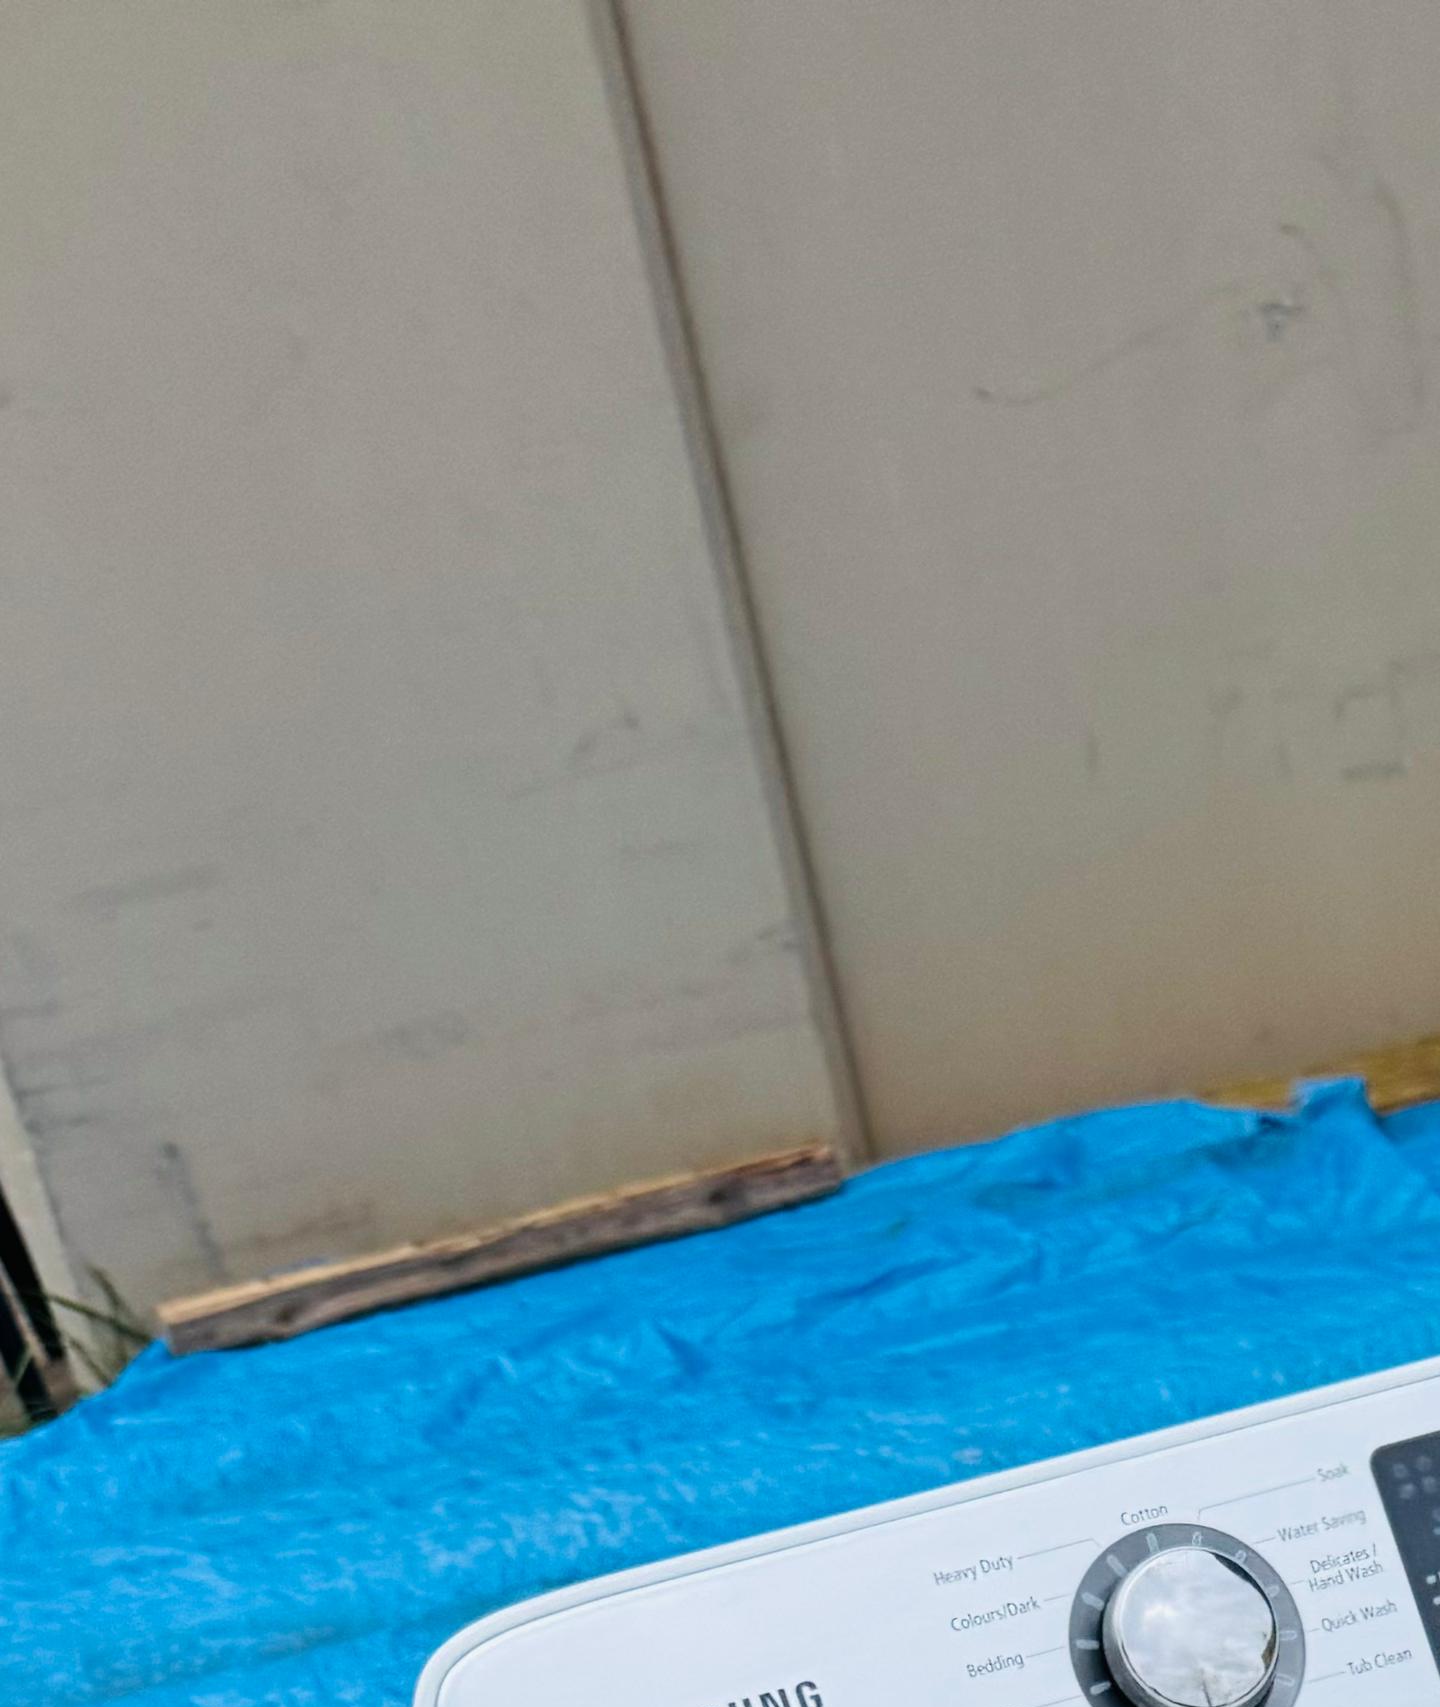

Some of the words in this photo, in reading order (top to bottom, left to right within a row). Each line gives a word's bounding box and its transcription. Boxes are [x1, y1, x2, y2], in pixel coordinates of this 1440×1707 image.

[1317, 1463, 1350, 1482] Soak
[1120, 1504, 1169, 1526] Cotton
[1277, 1522, 1319, 1542] Water
[1321, 1509, 1367, 1531] Saving
[933, 1562, 977, 1585] Heavy
[980, 1555, 1014, 1574] Duty
[1309, 1547, 1371, 1573] Delicates
[1308, 1572, 1344, 1592] Hand
[1349, 1562, 1384, 1582] Wash
[950, 1596, 1041, 1632] Colours/Dark
[1321, 1610, 1360, 1632] Quick
[1360, 1600, 1398, 1621] Wash
[966, 1652, 1025, 1678] Bedding
[1346, 1658, 1373, 1676] Tub
[1374, 1649, 1413, 1669] Clean
